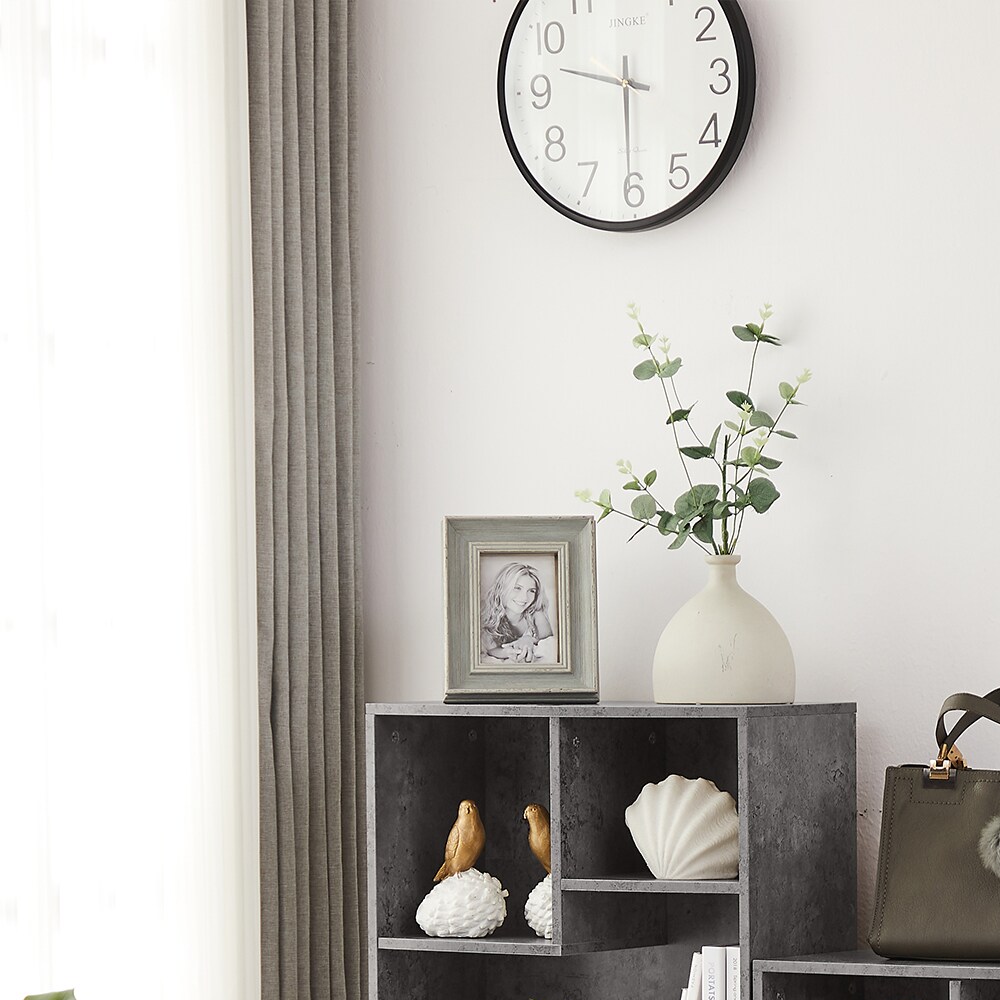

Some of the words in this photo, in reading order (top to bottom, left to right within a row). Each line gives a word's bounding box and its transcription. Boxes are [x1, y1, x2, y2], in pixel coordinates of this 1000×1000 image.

[537, 21, 565, 55] 10
[609, 16, 646, 28] JINGKE
[694, 6, 717, 42] 2
[530, 74, 551, 110] 9
[709, 57, 731, 95] 3
[544, 125, 566, 162] 8
[698, 112, 722, 148] 4
[577, 161, 598, 197] 7
[623, 171, 645, 208] 6
[668, 153, 690, 190] 5
